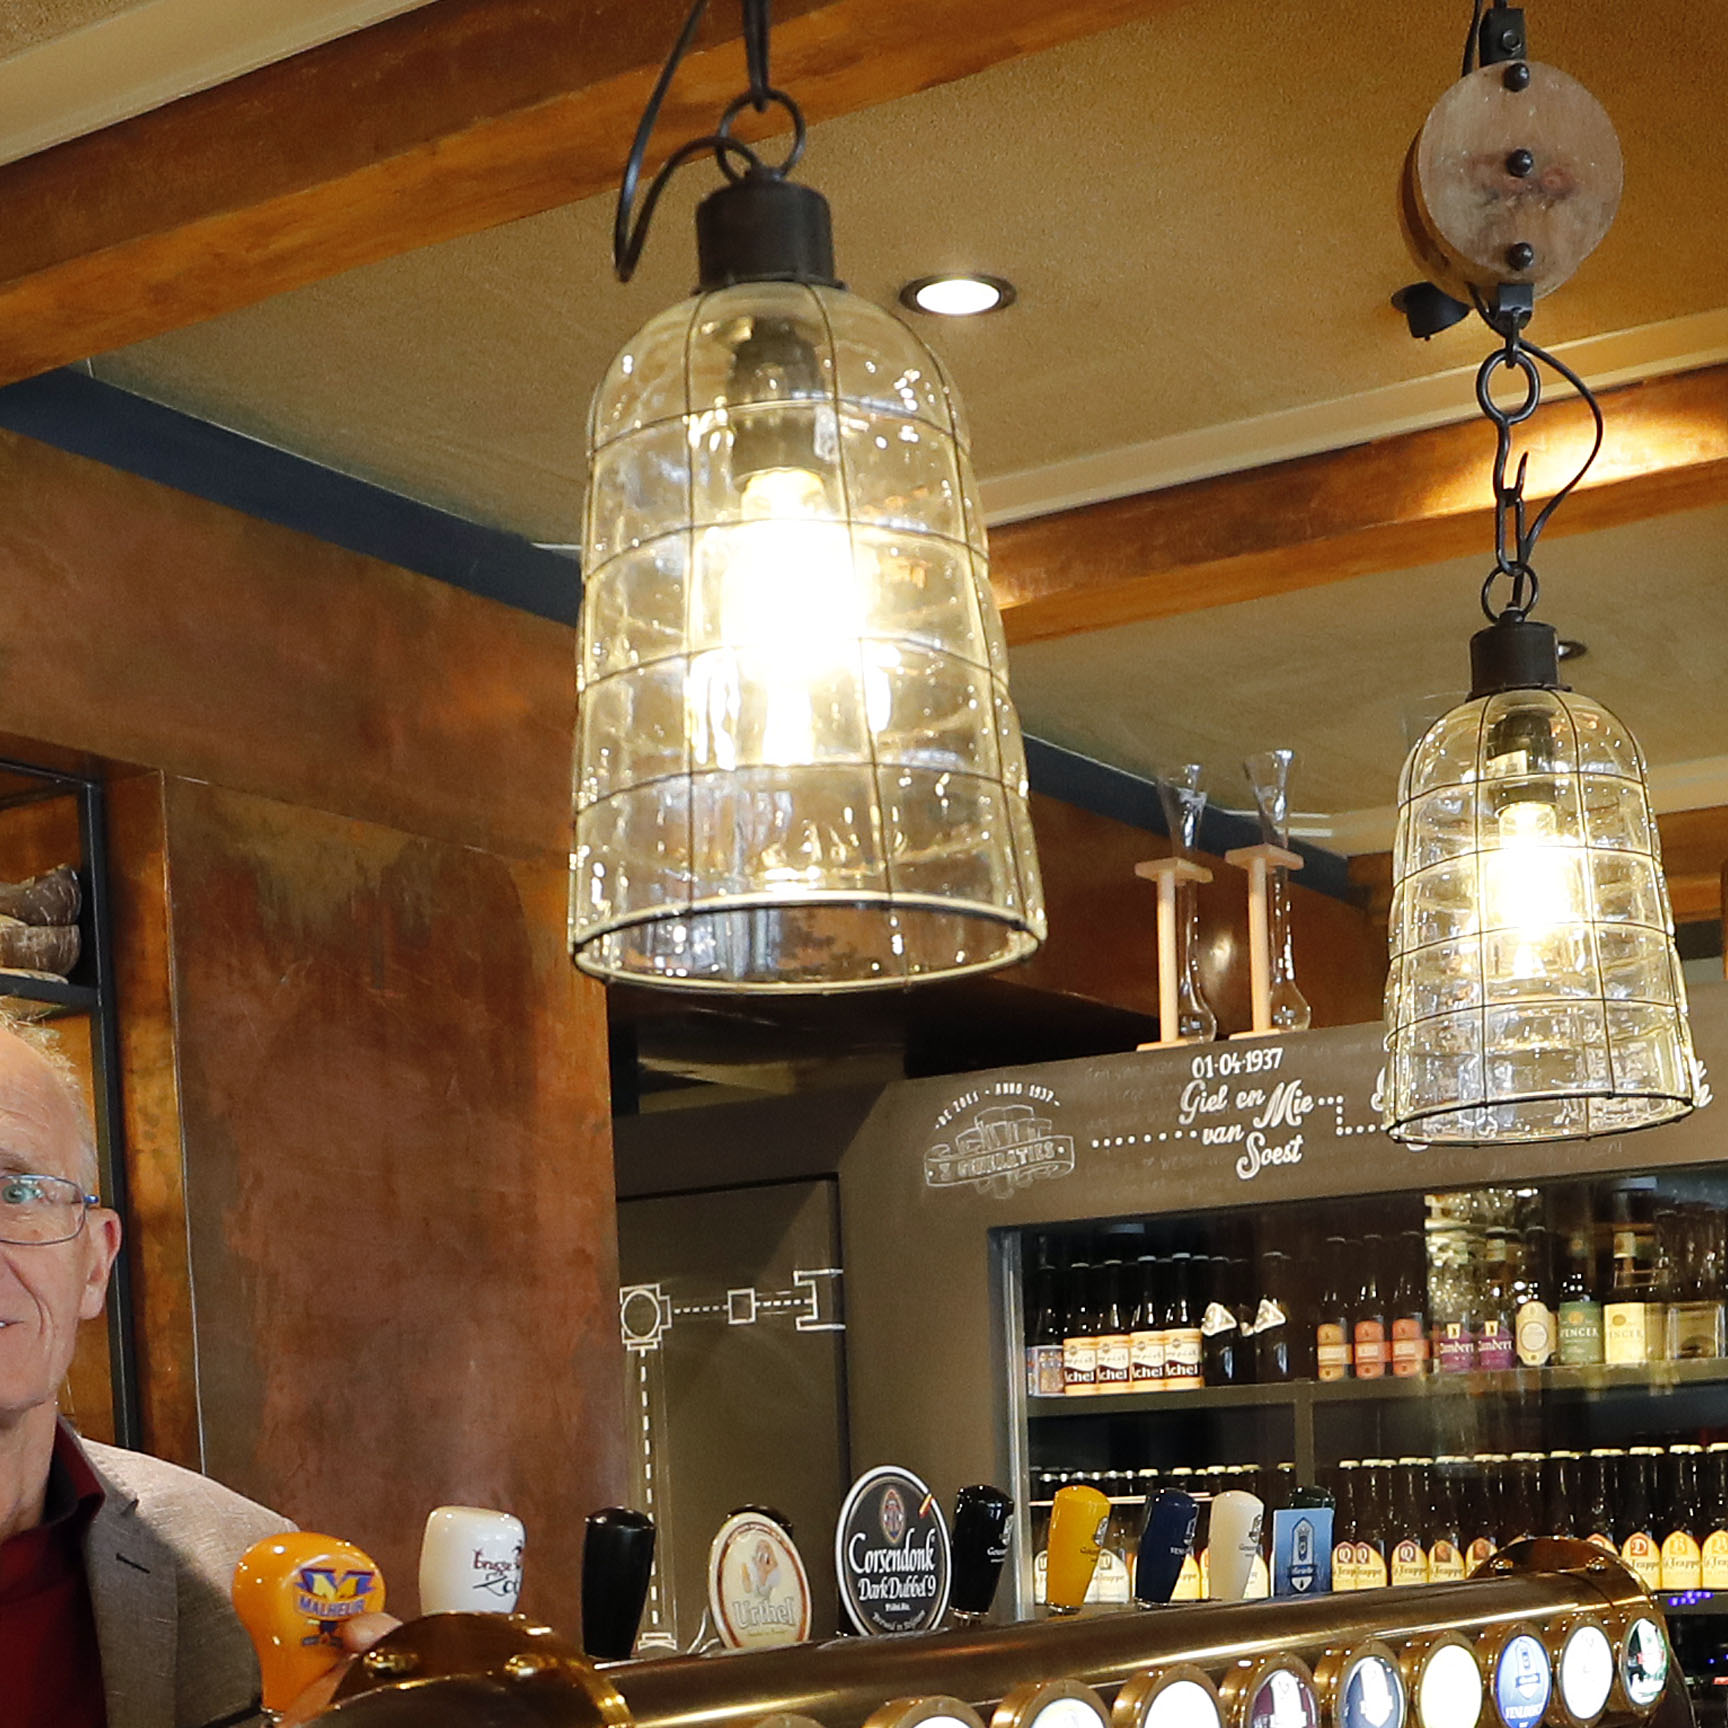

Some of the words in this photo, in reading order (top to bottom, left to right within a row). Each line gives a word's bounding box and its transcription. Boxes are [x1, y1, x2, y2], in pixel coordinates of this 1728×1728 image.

[1028, 1084, 1055, 1103] 1937
[1178, 1078, 1229, 1126] Giel
[1235, 1088, 1267, 1111] en
[1252, 1079, 1315, 1129] Mie
[1202, 1123, 1245, 1146] van
[1235, 1130, 1304, 1180] Soest
[848, 1527, 937, 1575] Corsendonk
[858, 1576, 889, 1601] Dark
[888, 1574, 928, 1600] Dubbel
[927, 1574, 937, 1598] 9
